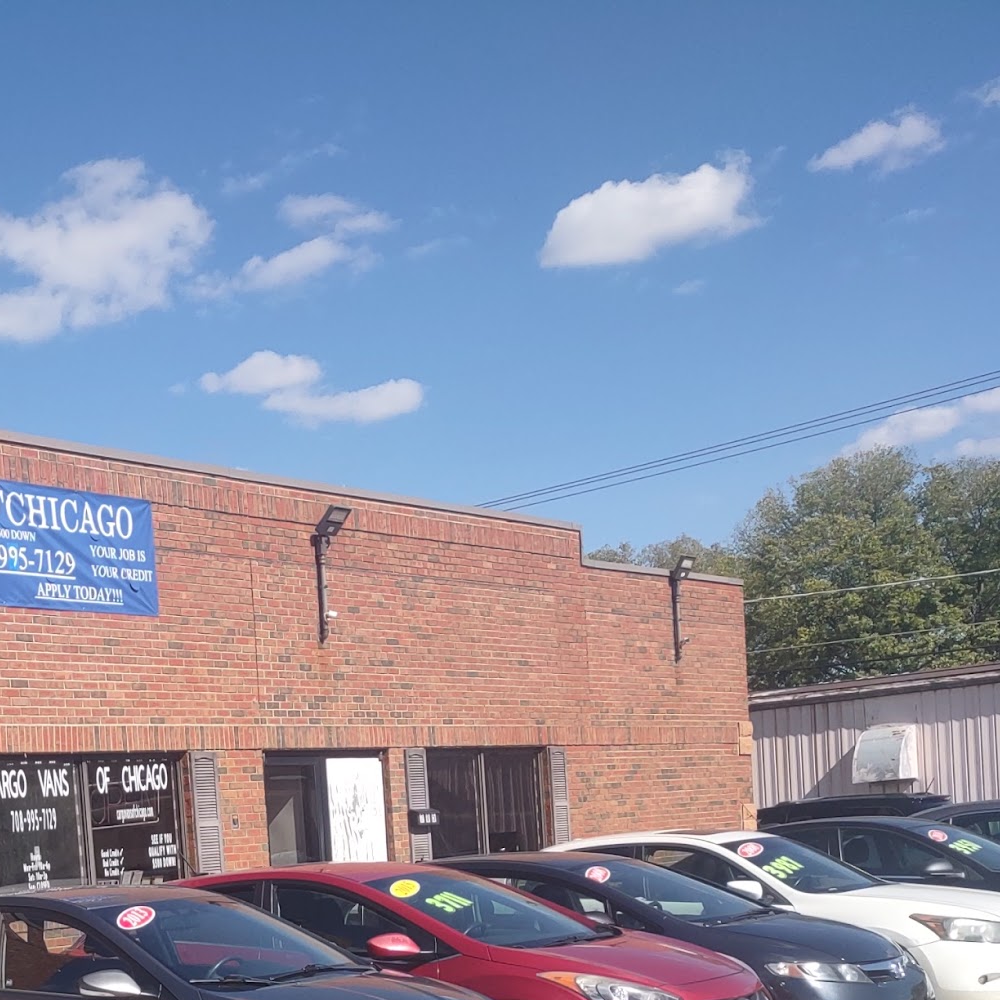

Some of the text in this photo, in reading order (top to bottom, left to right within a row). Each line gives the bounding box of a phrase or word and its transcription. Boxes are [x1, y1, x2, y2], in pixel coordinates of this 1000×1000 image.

[11, 528, 36, 542] DOWN
[89, 544, 146, 562] YOUR JOB IS
[91, 564, 153, 582] YOUR CREDIT
[37, 582, 123, 603] APPLY TODAY!!!
[37, 768, 69, 798] VANS
[96, 766, 110, 794] OF
[121, 763, 168, 793] CHICAGO
[10, 807, 57, 833] 708-995-7129
[122, 907, 148, 927] 2013
